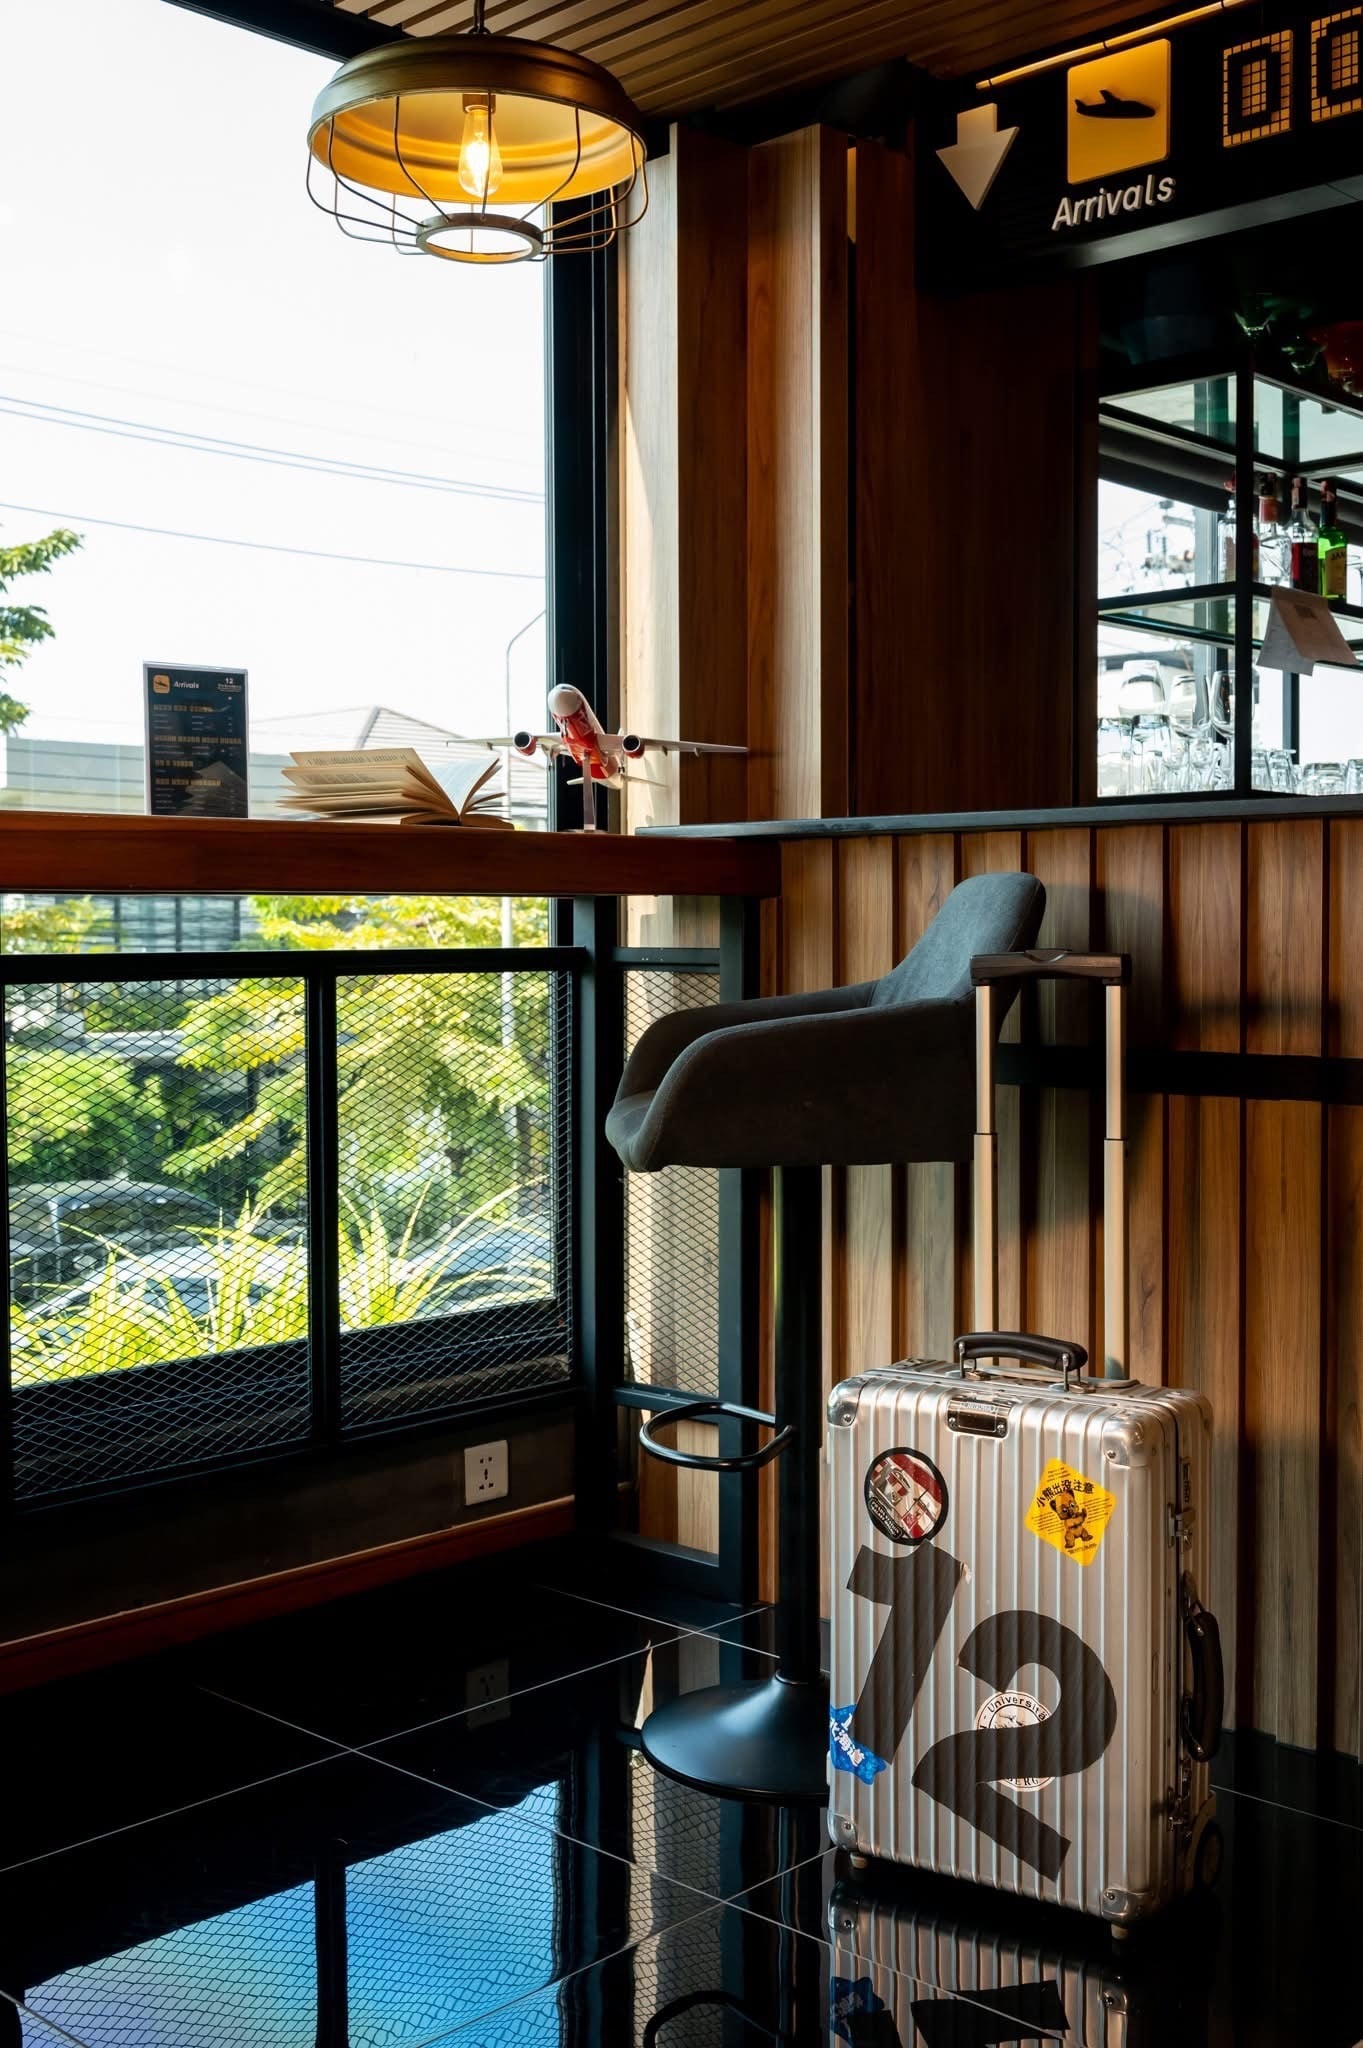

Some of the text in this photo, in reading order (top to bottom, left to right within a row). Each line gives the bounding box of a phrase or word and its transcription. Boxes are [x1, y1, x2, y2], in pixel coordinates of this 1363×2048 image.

[1051, 174, 1177, 232] Arrivals
[173, 680, 200, 690] Arrivals
[987, 1695, 1047, 1722] Universitä
